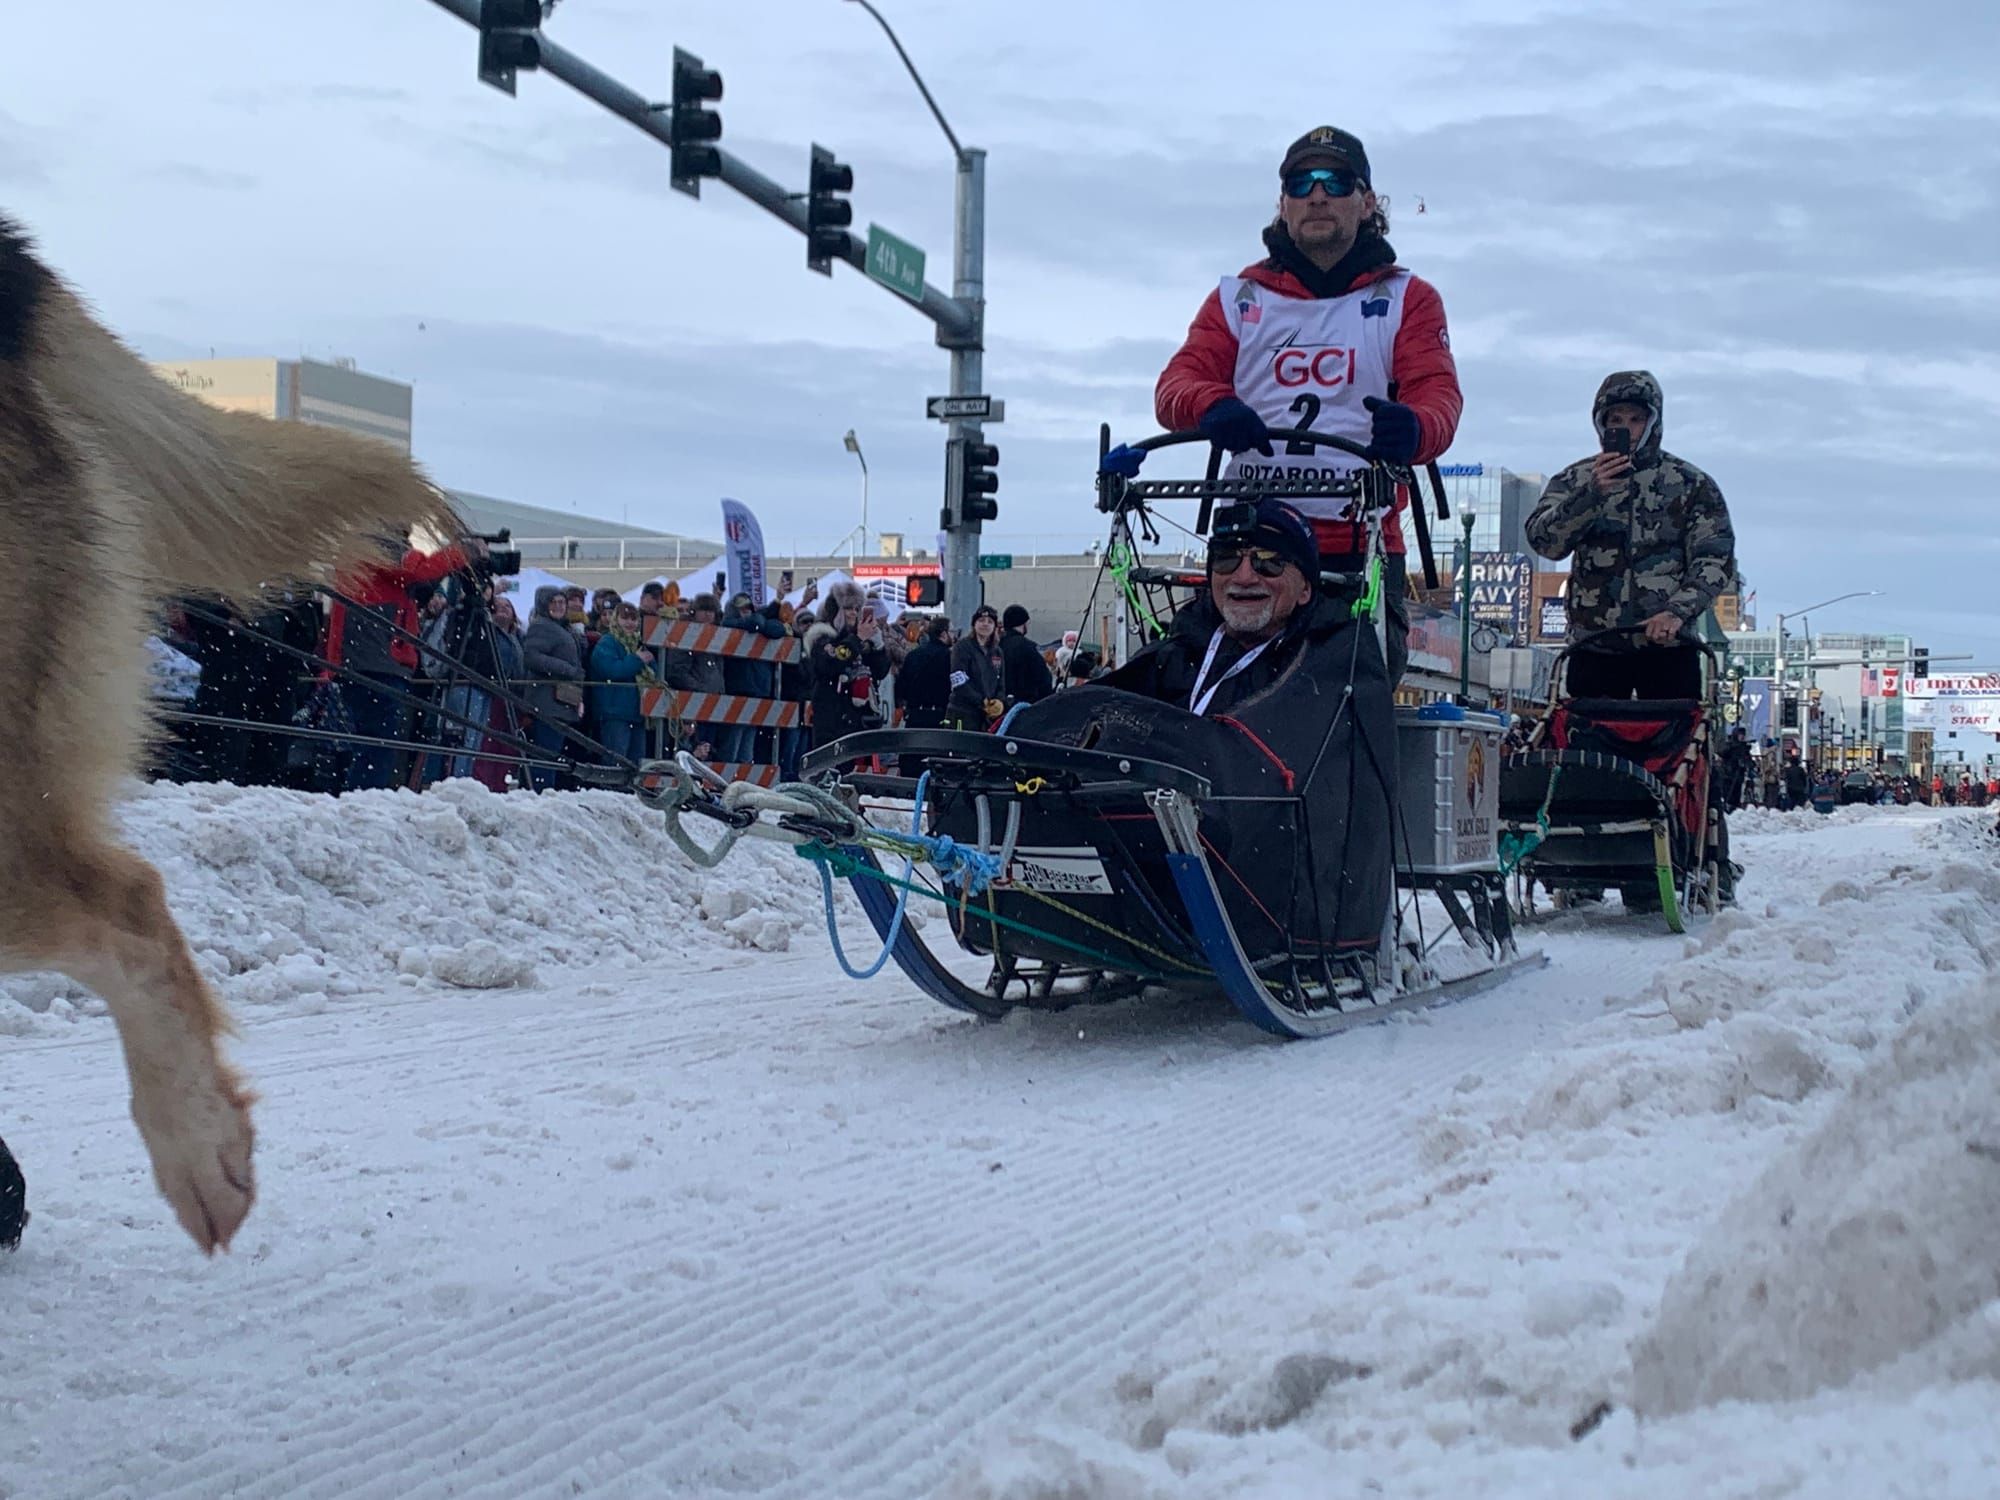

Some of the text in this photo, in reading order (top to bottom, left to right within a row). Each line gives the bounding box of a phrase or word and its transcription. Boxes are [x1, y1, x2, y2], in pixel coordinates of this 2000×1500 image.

[875, 241, 916, 288] 4th Ave
[1274, 347, 1356, 387] GCI
[945, 401, 983, 411] ONE WAY
[1286, 393, 1321, 456] 2
[1484, 553, 1511, 563] AVE
[870, 567, 883, 575] SALE
[1454, 564, 1518, 582] ARMY
[1454, 586, 1518, 604] NAVY
[1951, 716, 1989, 724] START
